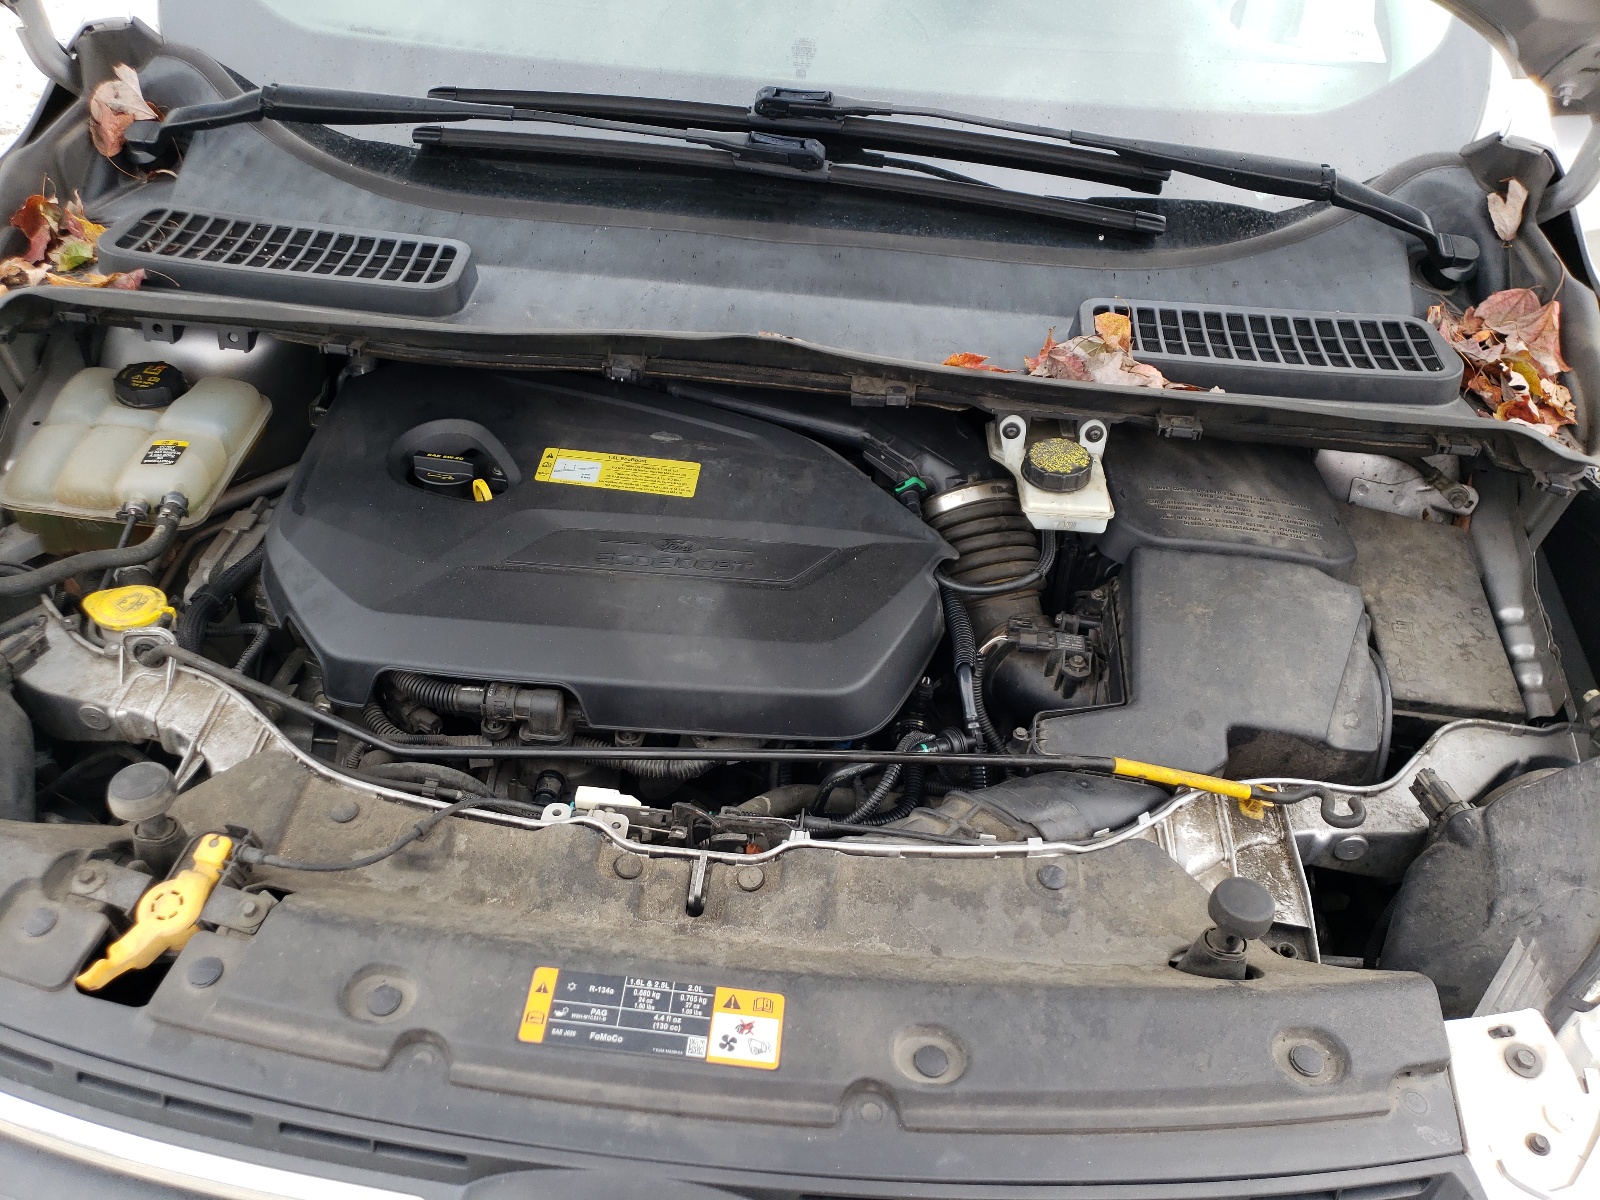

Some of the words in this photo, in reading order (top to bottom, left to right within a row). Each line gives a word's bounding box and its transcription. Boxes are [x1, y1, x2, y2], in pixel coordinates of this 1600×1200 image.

[589, 984, 615, 995] R-134a
[687, 984, 704, 993] 2.0L
[651, 990, 661, 1000] kg
[698, 995, 708, 1005] kg
[590, 1008, 608, 1016] PAG
[653, 1014, 665, 1022] 4.4
[652, 1021, 669, 1031] (130
[669, 1024, 682, 1032] cc)
[589, 1031, 623, 1043] FoMoCo
